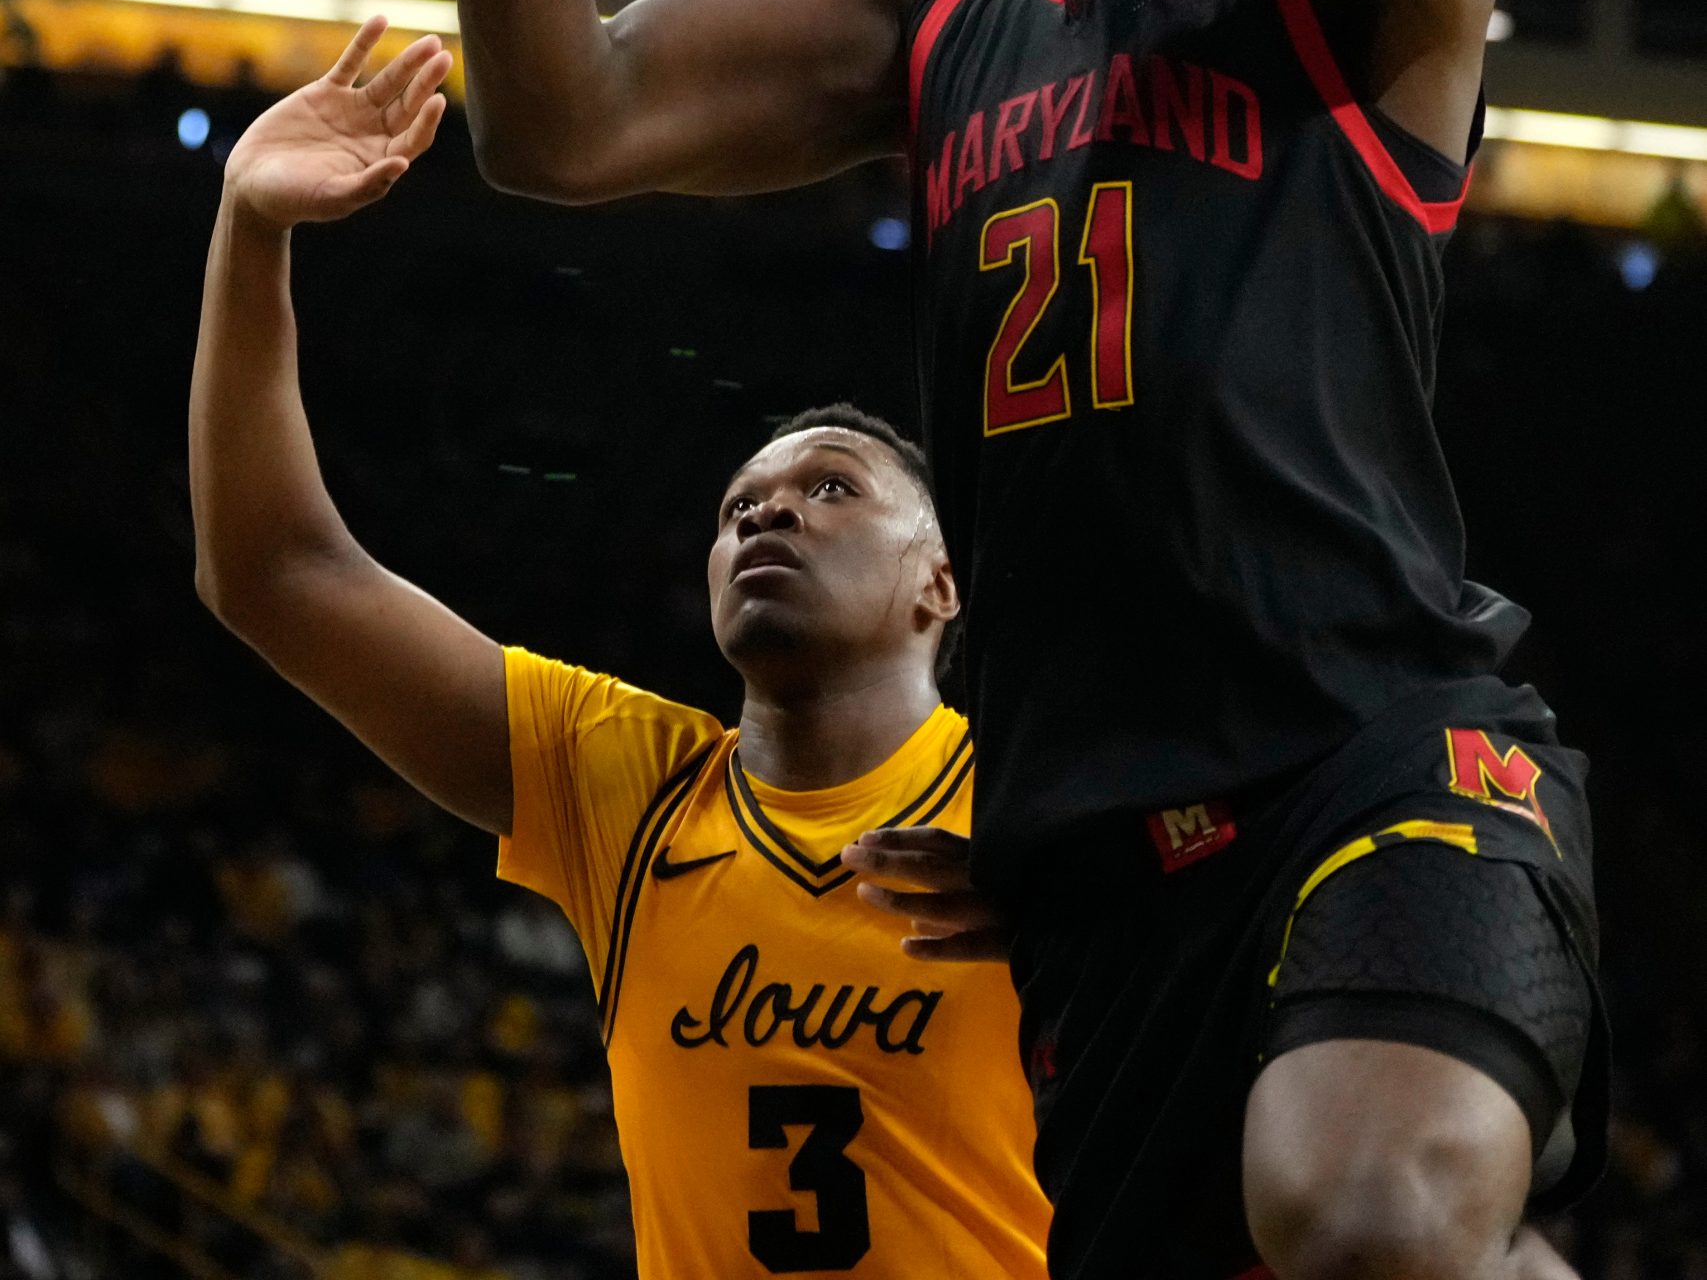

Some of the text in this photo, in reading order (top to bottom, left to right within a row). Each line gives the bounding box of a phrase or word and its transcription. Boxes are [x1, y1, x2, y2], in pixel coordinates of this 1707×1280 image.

[925, 52, 1264, 253] MARYLAND
[979, 180, 1135, 438] 21
[1161, 803, 1217, 850] M
[669, 943, 945, 1055] Iowa
[747, 1084, 872, 1274] 3
